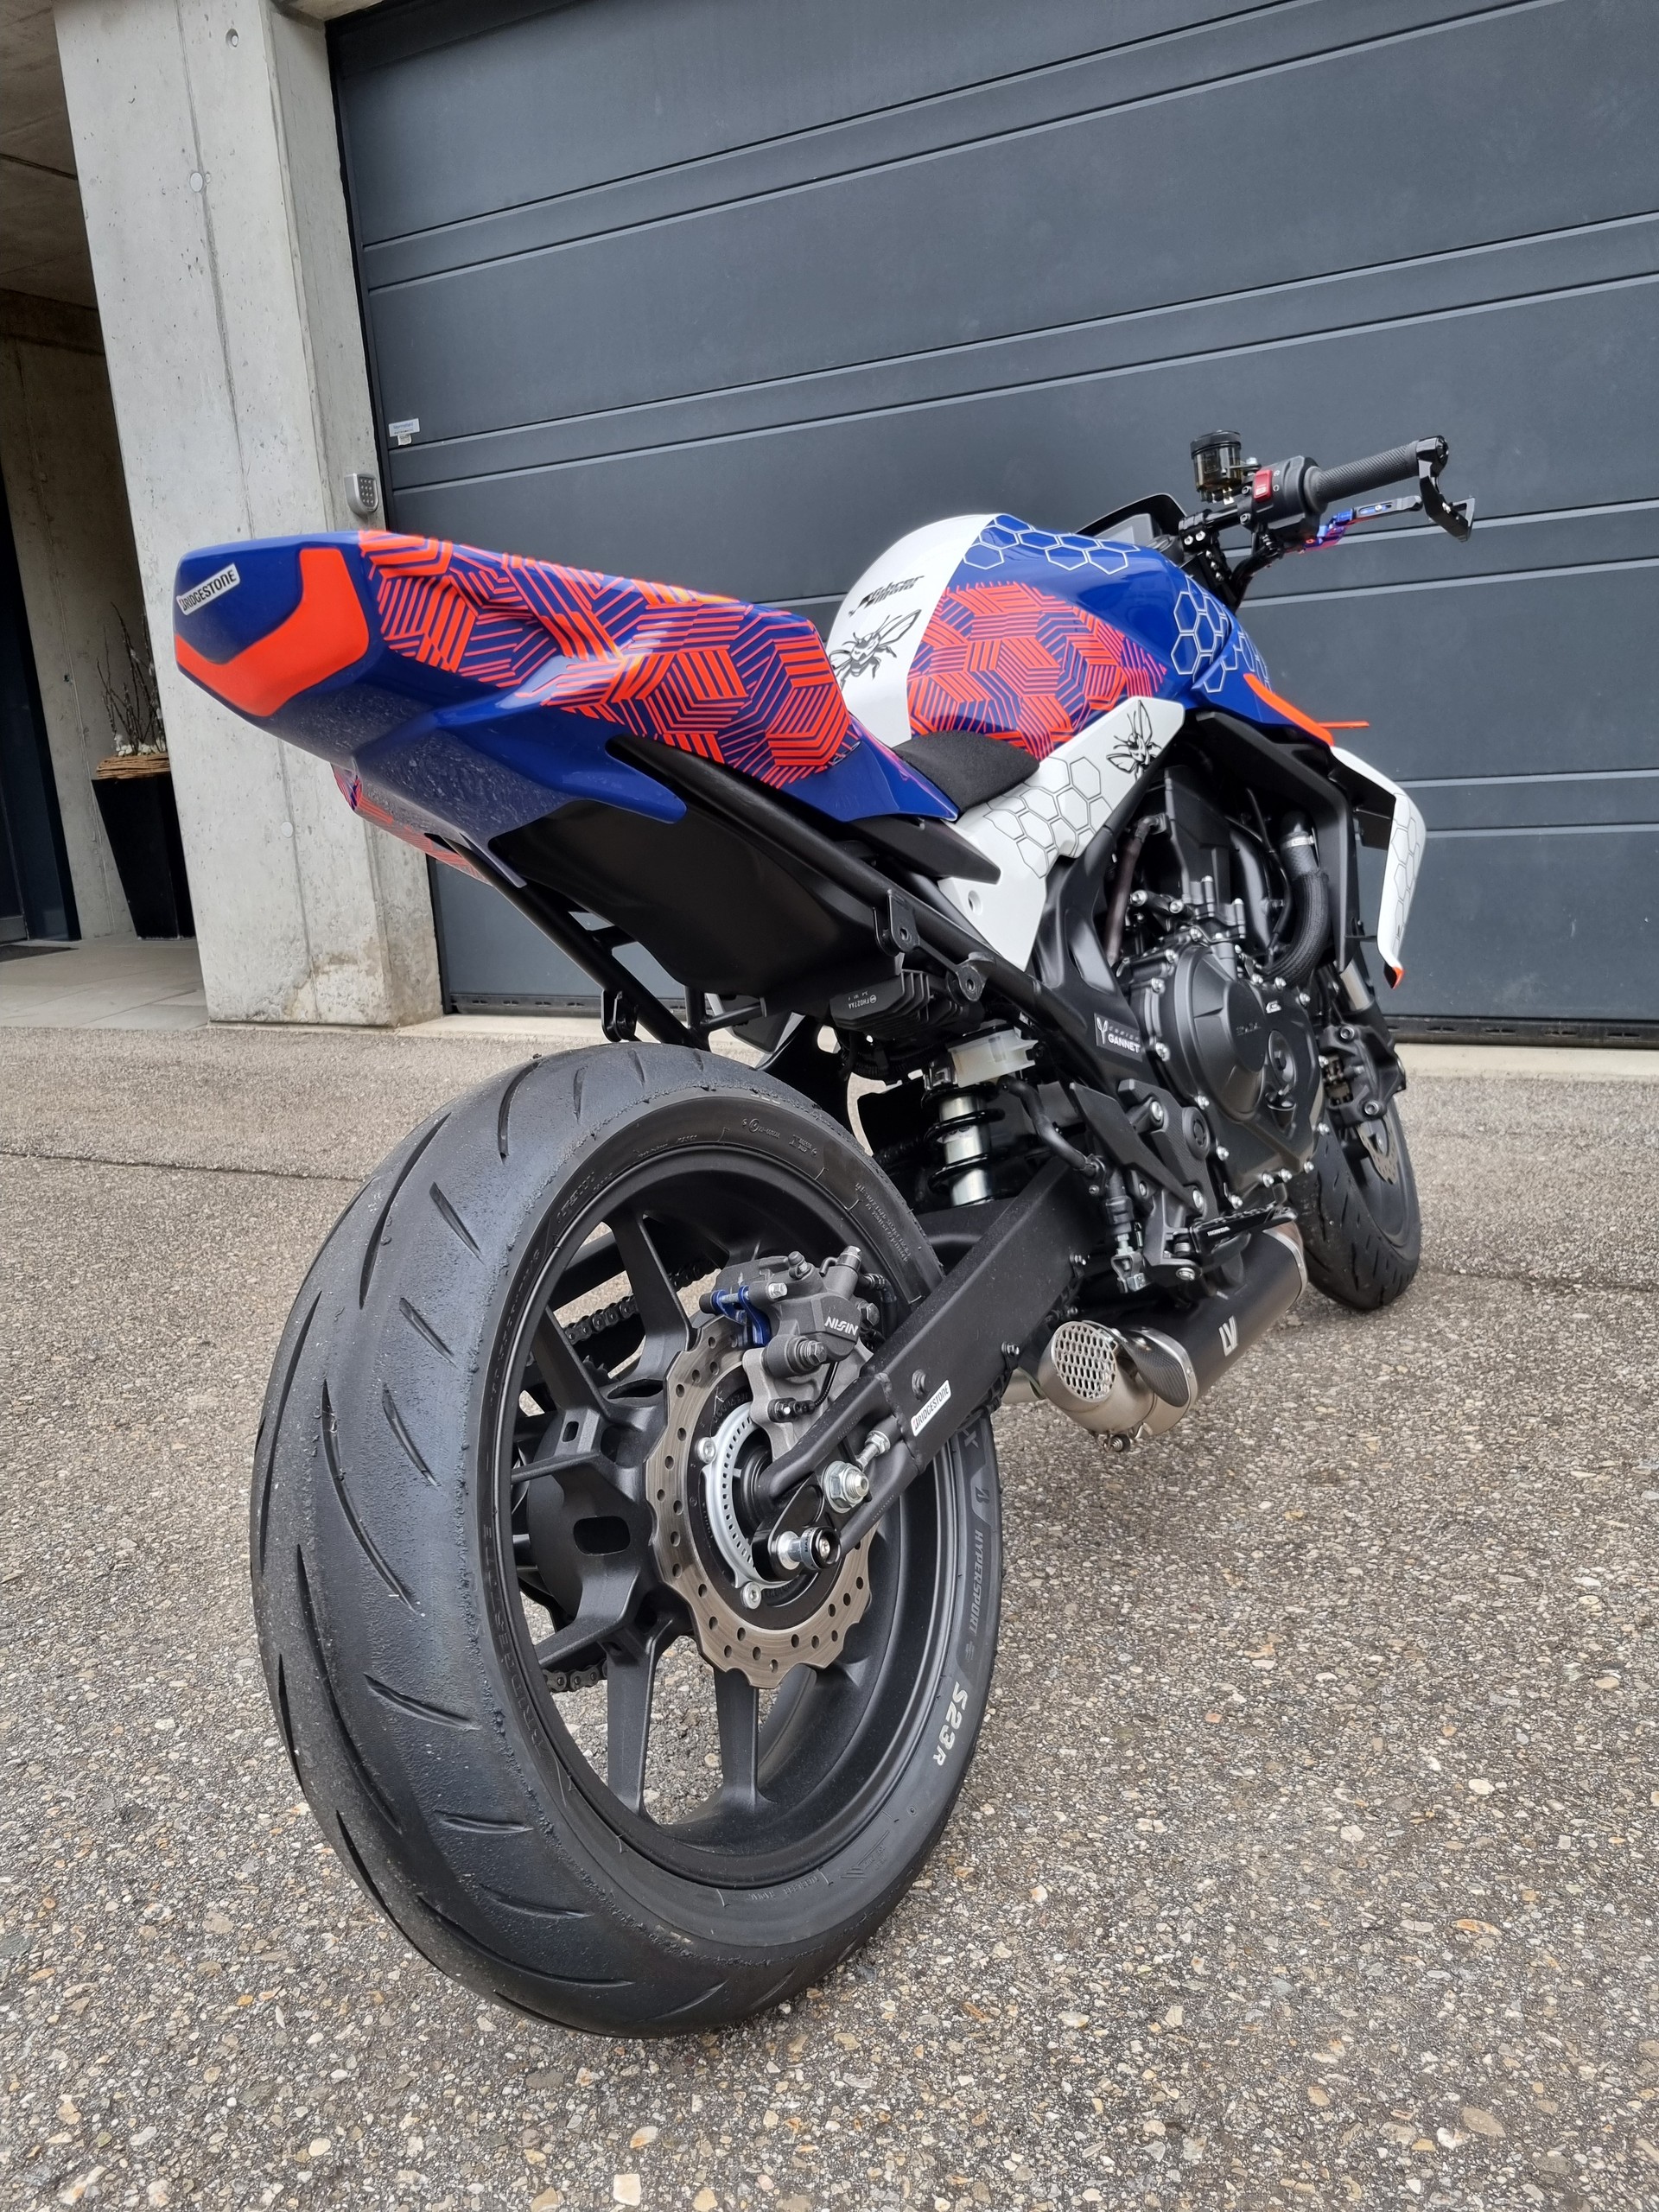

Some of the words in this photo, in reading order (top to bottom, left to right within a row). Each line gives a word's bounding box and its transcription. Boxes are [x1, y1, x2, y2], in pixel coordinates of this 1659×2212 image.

[178, 569, 237, 612] BRIDGESTONE
[1108, 1033, 1141, 1053] GANNET
[1207, 1226, 1230, 1236] HONDA
[913, 1384, 950, 1431] BRIDGESTONE
[969, 1529, 984, 1637] HYPERSPORT
